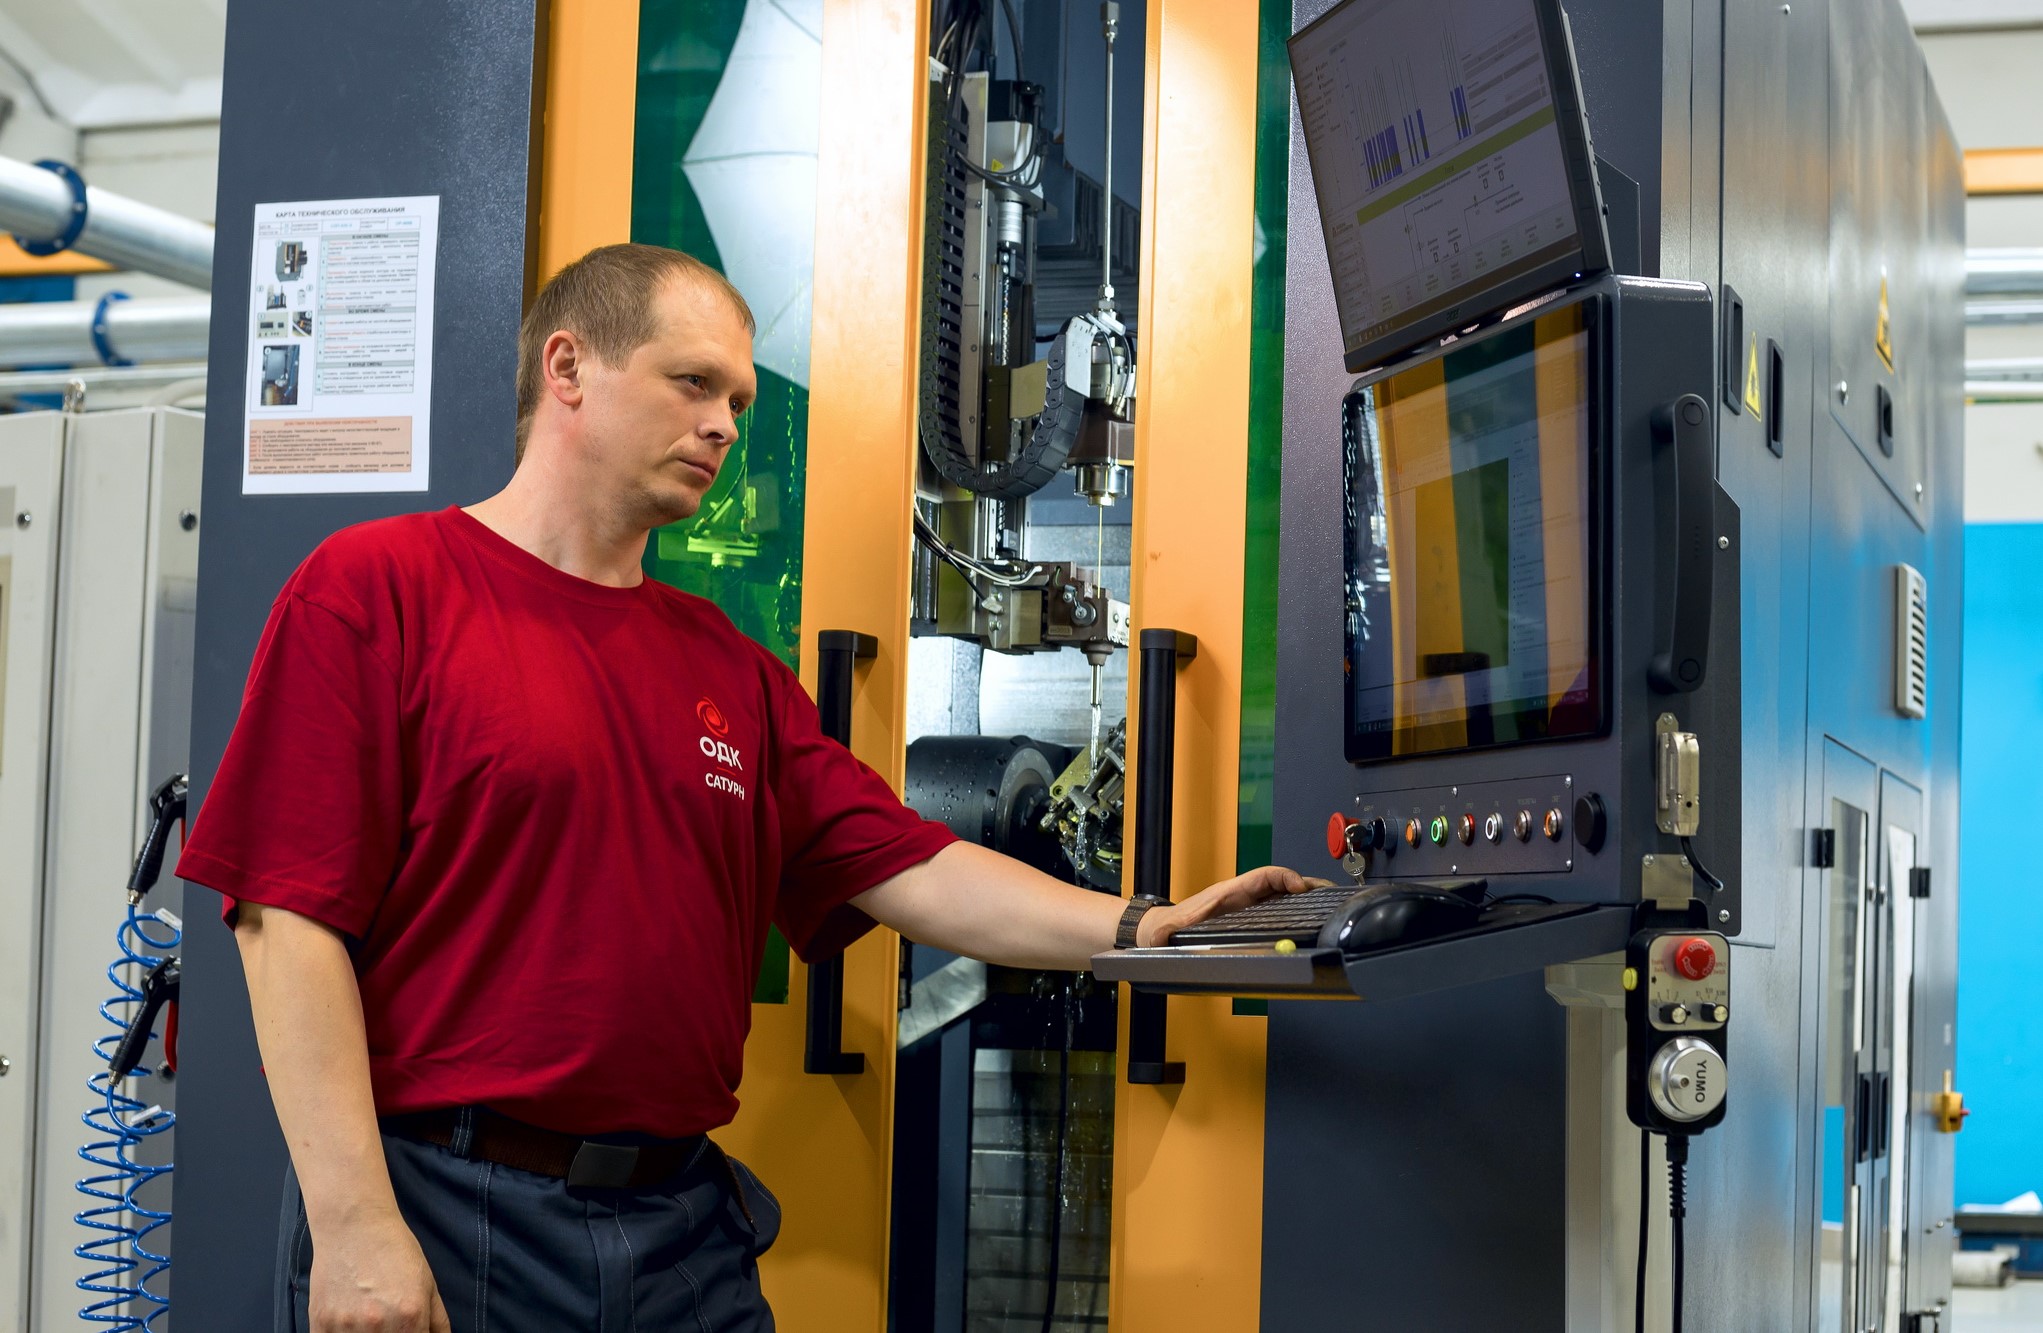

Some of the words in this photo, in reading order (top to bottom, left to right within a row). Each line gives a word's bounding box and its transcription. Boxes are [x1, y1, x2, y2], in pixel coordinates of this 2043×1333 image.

[298, 208, 349, 217] ТЕХНИЧЕСКОГО
[350, 206, 405, 215] ОБСЛУЖИВАНИЯ
[699, 736, 743, 771] ОДК
[705, 773, 745, 800] САТУРН
[1695, 1060, 1707, 1103] YUMO
